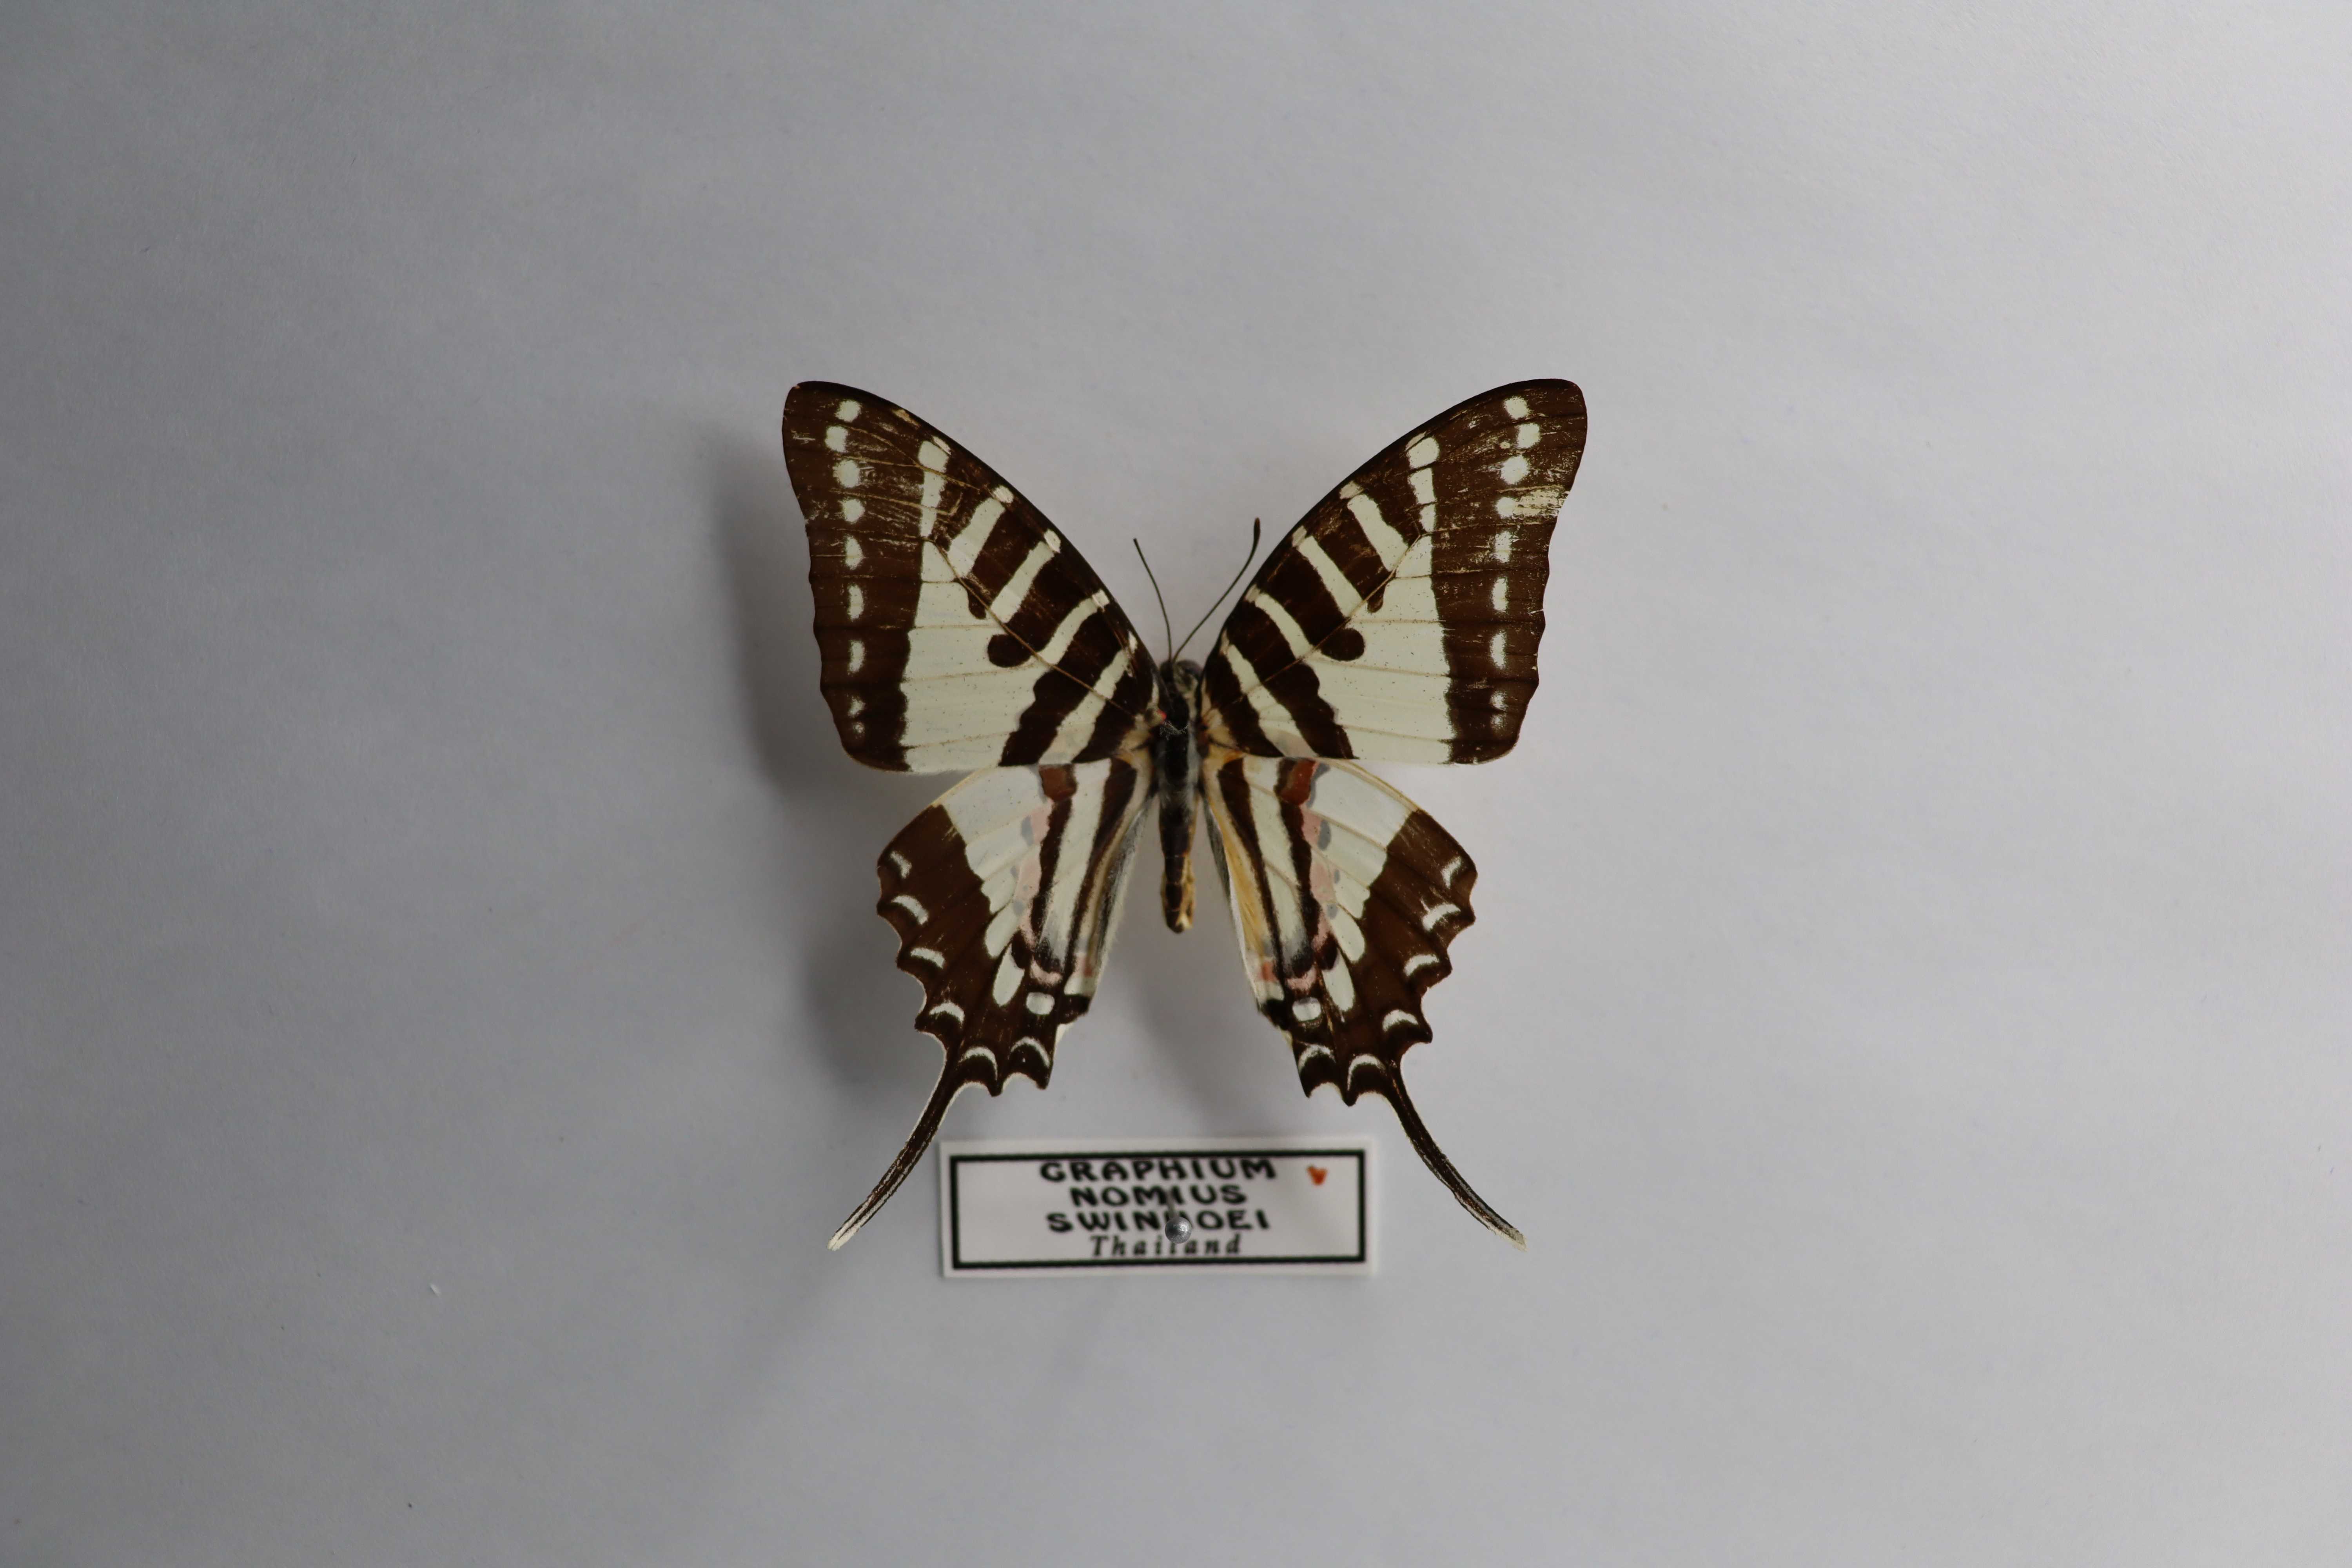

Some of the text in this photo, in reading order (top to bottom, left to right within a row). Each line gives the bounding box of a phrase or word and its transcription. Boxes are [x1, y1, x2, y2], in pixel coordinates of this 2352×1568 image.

[1040, 1158, 1276, 1182] GRAPHIUM
[1070, 1185, 1247, 1207] NOMIUS
[1047, 1209, 1270, 1232] SWINOEI
